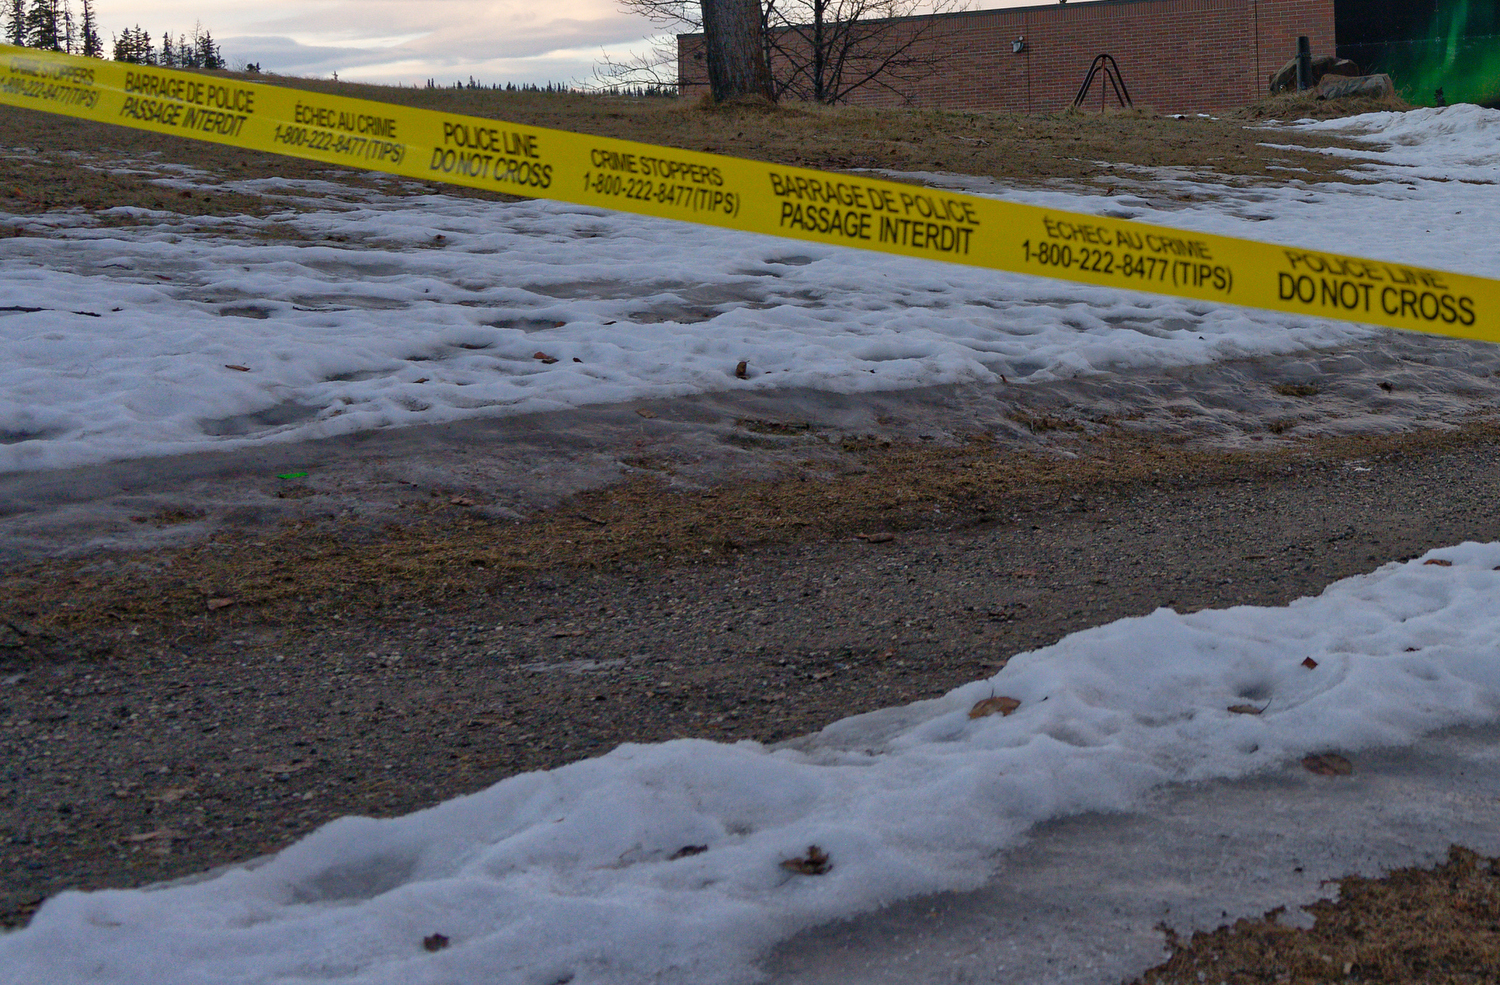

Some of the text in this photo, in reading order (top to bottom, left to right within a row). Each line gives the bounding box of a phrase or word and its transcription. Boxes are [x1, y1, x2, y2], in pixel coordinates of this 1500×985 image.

[125, 71, 255, 113] BARRAGE DE POLICE
[120, 97, 247, 136] PASSAGE INTERDIT
[295, 100, 396, 138] ÉCHEC AU CRIME
[274, 124, 406, 166] 1-800-222-8477(TIPS)
[443, 121, 540, 159] POLICE LINE
[430, 147, 554, 189] DO NOT CROSS
[590, 148, 724, 187] CRIME STOPPERS
[584, 171, 740, 218] 1-800-222-8477(TIPS)
[769, 172, 980, 226] BARRAGE DE POLICE
[780, 201, 974, 255] PASSAGE INTERDIT
[1043, 215, 1213, 261] ÉCHEC AU CRIME
[1022, 239, 1233, 295] 1-800-222-8477(TIPS)
[1284, 249, 1448, 290] POLICE LINE
[1278, 272, 1476, 327] DO NOT CROSS
